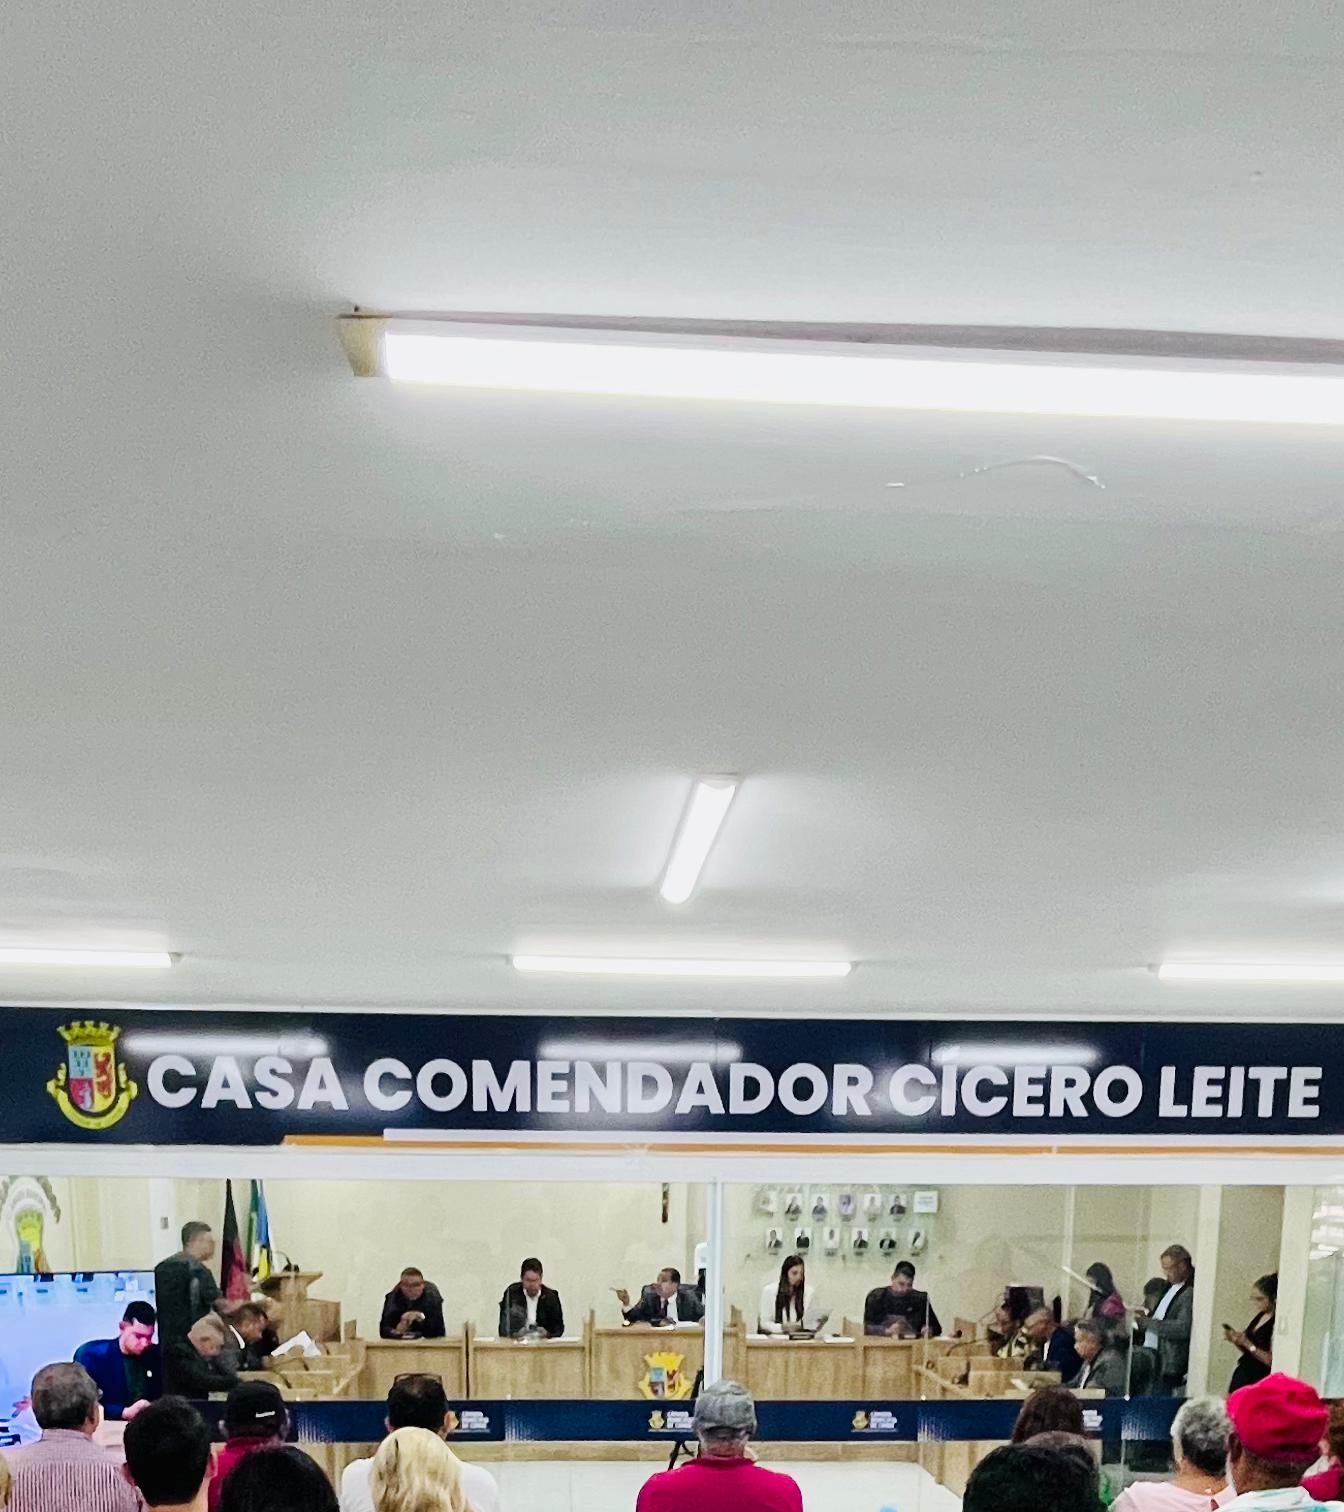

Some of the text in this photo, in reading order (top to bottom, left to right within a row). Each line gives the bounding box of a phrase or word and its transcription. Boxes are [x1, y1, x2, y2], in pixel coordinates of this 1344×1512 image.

[147, 1054, 1323, 1119] CASA COMENDADOR CICERO LEITE
